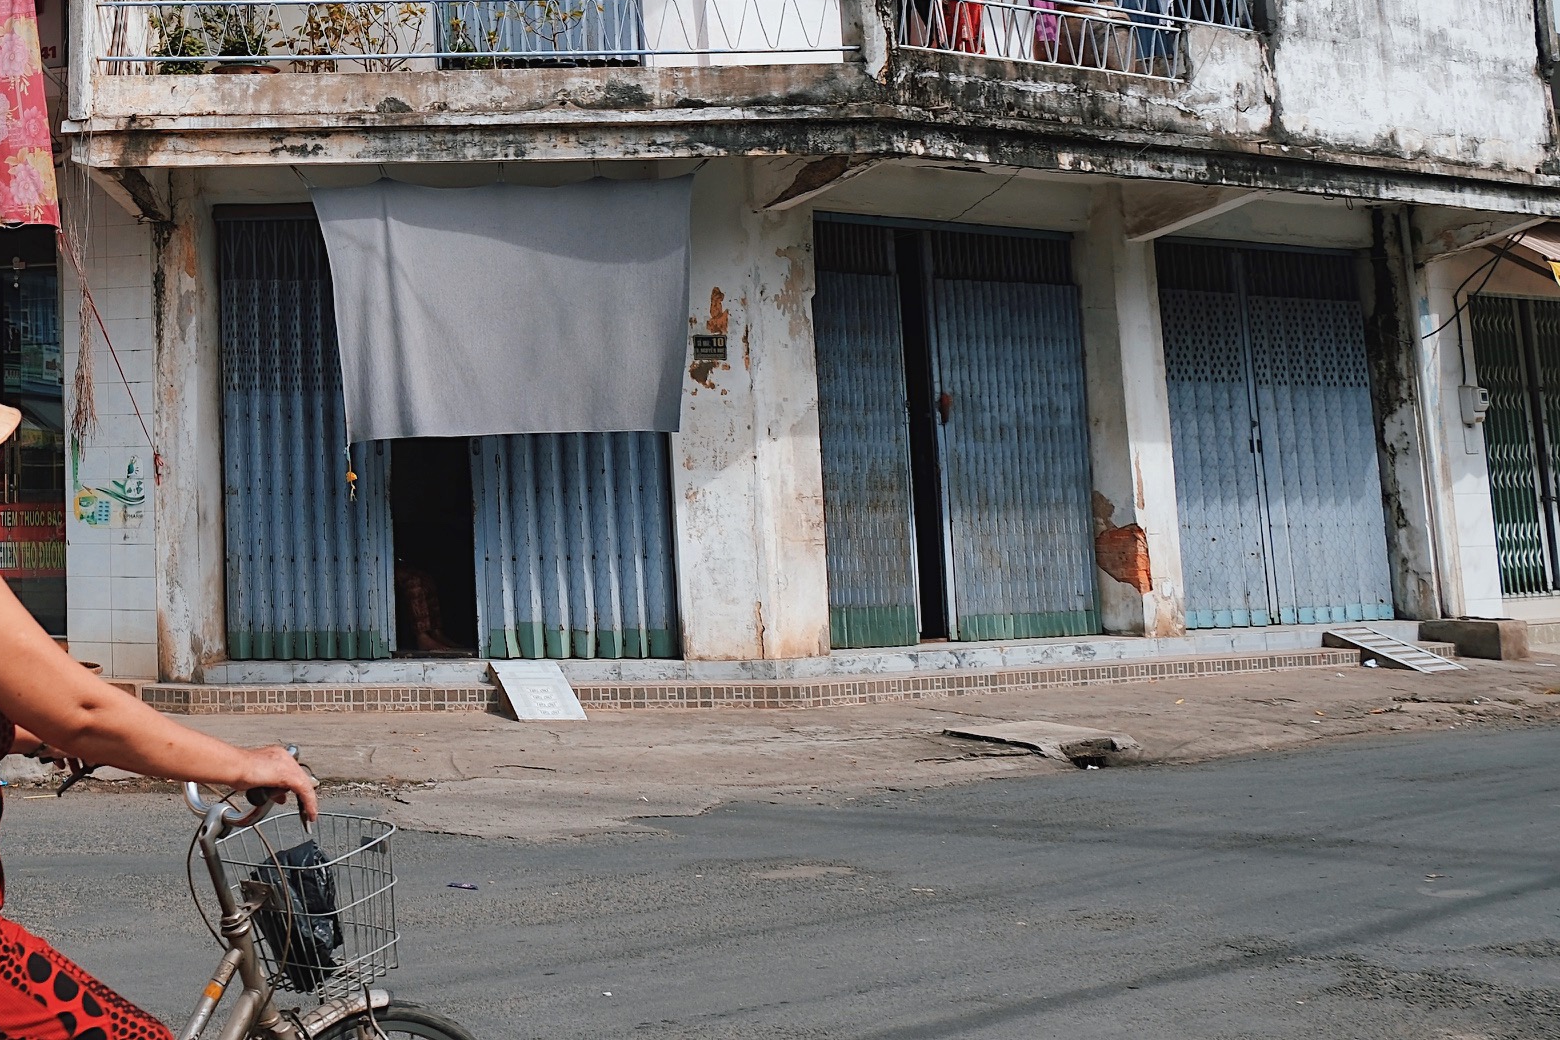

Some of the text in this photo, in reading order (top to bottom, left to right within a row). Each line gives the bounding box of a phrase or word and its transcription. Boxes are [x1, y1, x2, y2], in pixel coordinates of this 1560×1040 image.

[712, 337, 725, 347] 10
[0, 508, 18, 531] TIỆM
[20, 505, 45, 527] THUỐC
